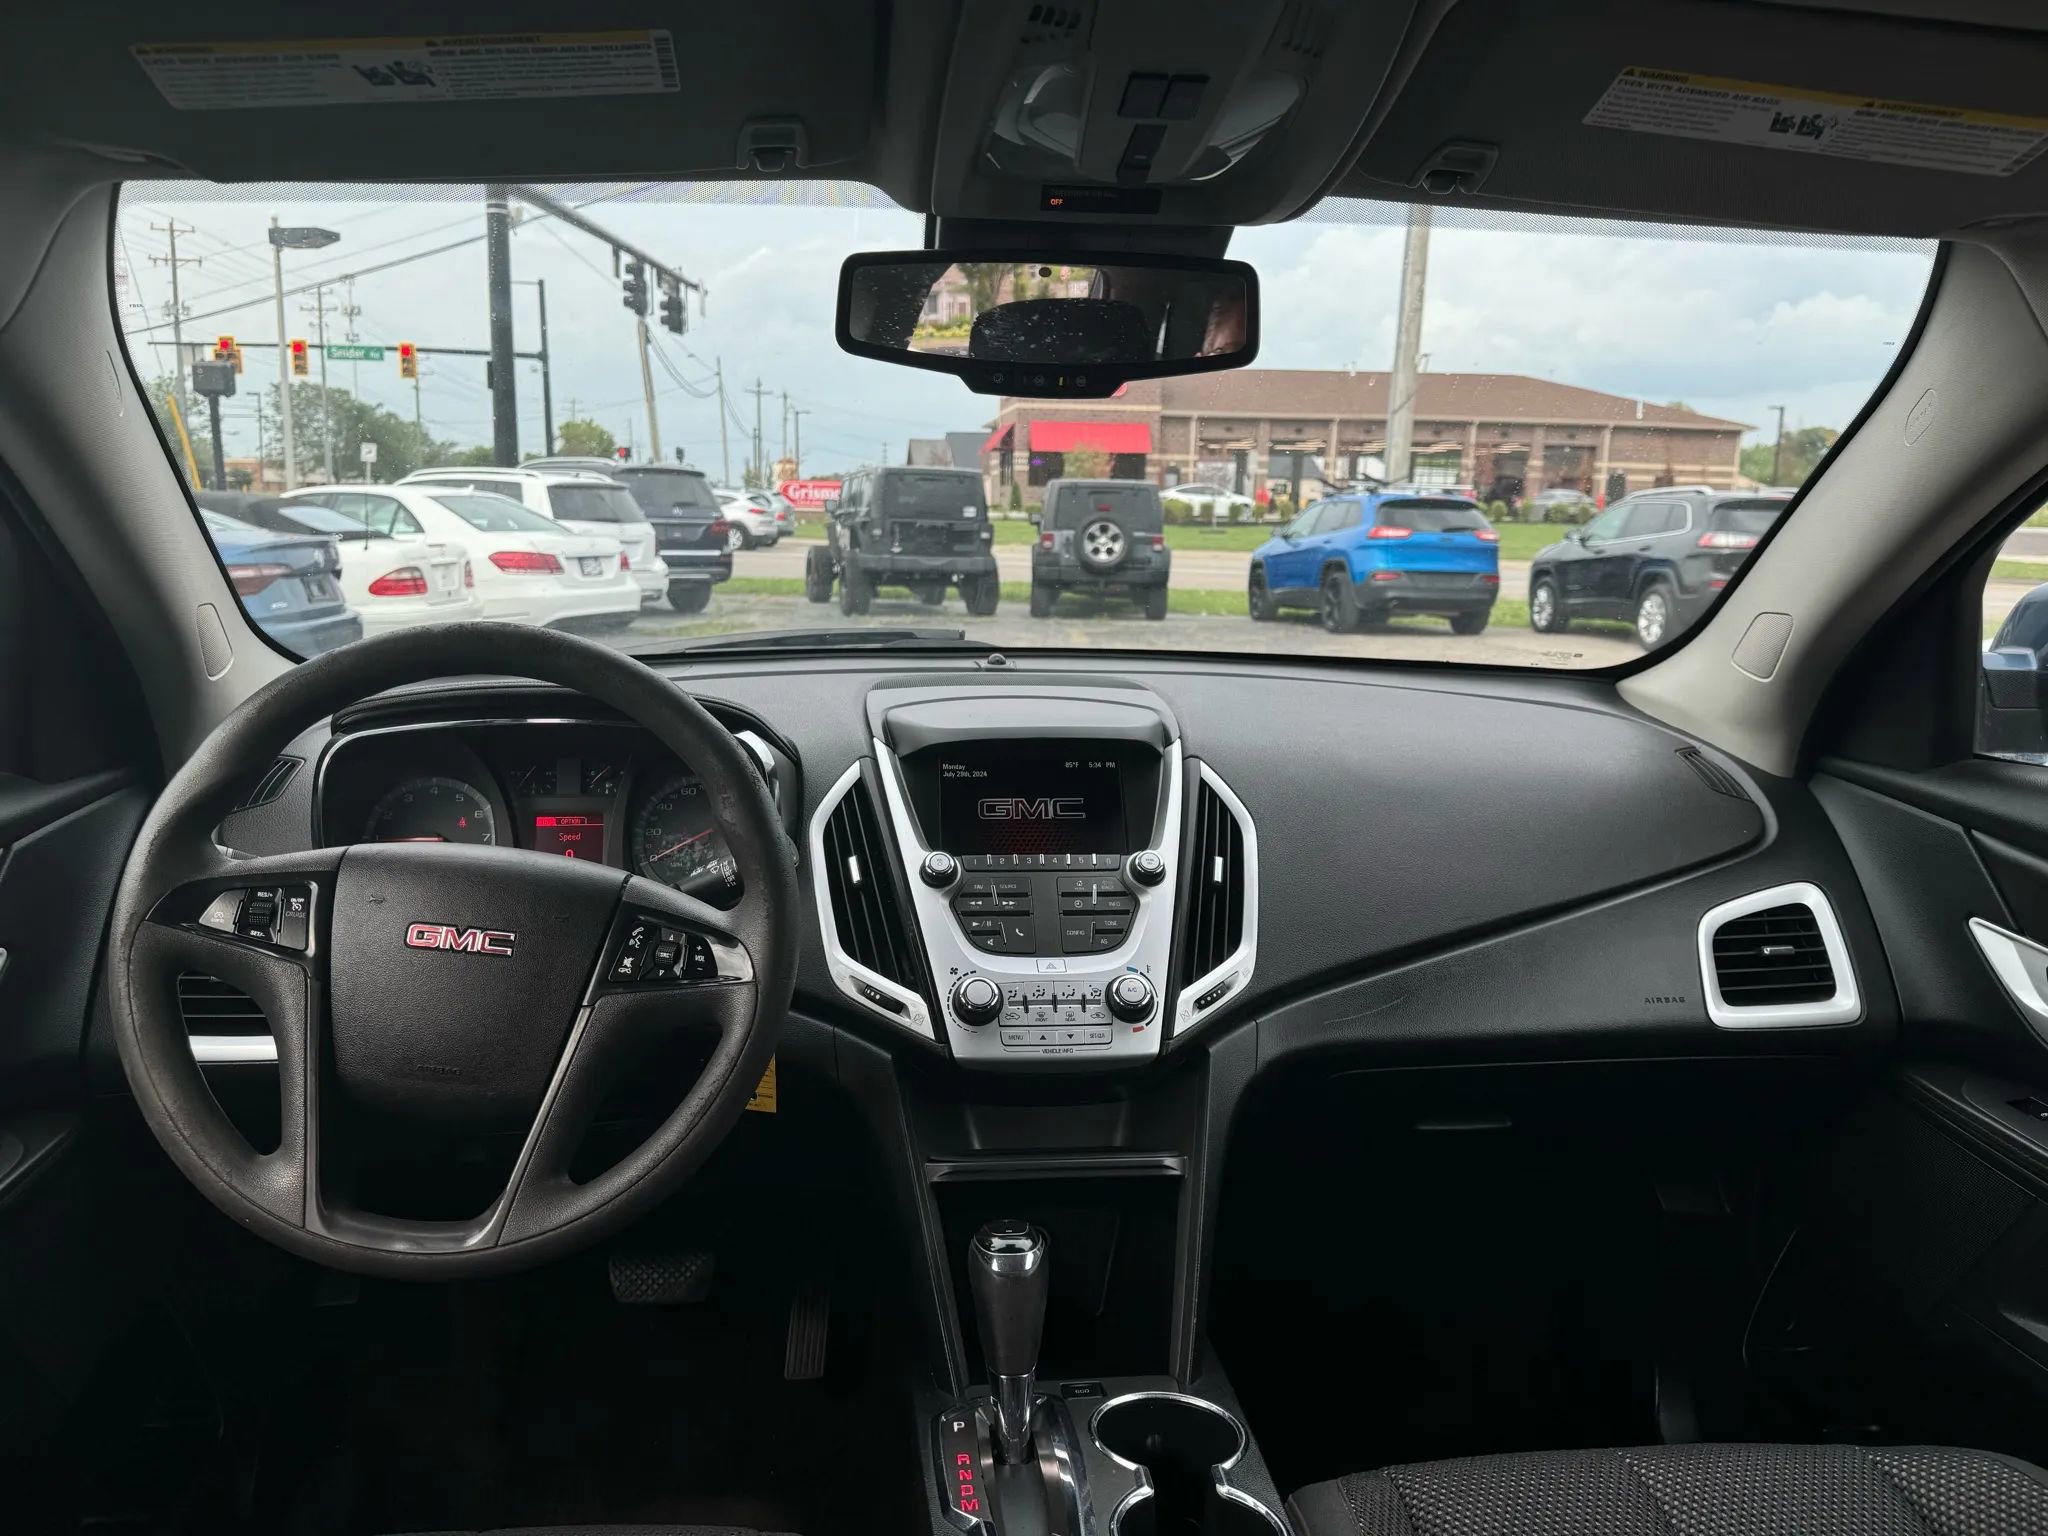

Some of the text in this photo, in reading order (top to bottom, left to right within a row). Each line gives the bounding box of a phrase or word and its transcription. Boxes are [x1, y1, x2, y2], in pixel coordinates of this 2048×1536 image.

[1639, 70, 1689, 83] WARNING
[1616, 78, 1644, 88] EVEN
[1646, 82, 1673, 92] WITH
[1674, 86, 1729, 99] ADVANCED
[1050, 197, 1064, 206] OFF
[943, 763, 966, 771] Monday
[943, 770, 956, 778] July
[973, 770, 988, 778] 2024
[430, 786, 439, 795] 4
[681, 787, 697, 796] 60
[404, 794, 414, 802] 3
[455, 793, 464, 802] 5
[656, 801, 673, 810] 40
[977, 797, 1087, 820] GMC
[474, 810, 483, 819] 6
[646, 828, 661, 836] 20
[481, 833, 490, 842] 7
[559, 832, 581, 842] Speed
[285, 910, 307, 919] CRUISE
[406, 923, 516, 957] GMC
[1644, 996, 1686, 1004] AIRBAG
[953, 1421, 966, 1432] P
[956, 1453, 971, 1465] R
[958, 1469, 973, 1481] N
[960, 1484, 975, 1496] D
[960, 1498, 979, 1511] M
